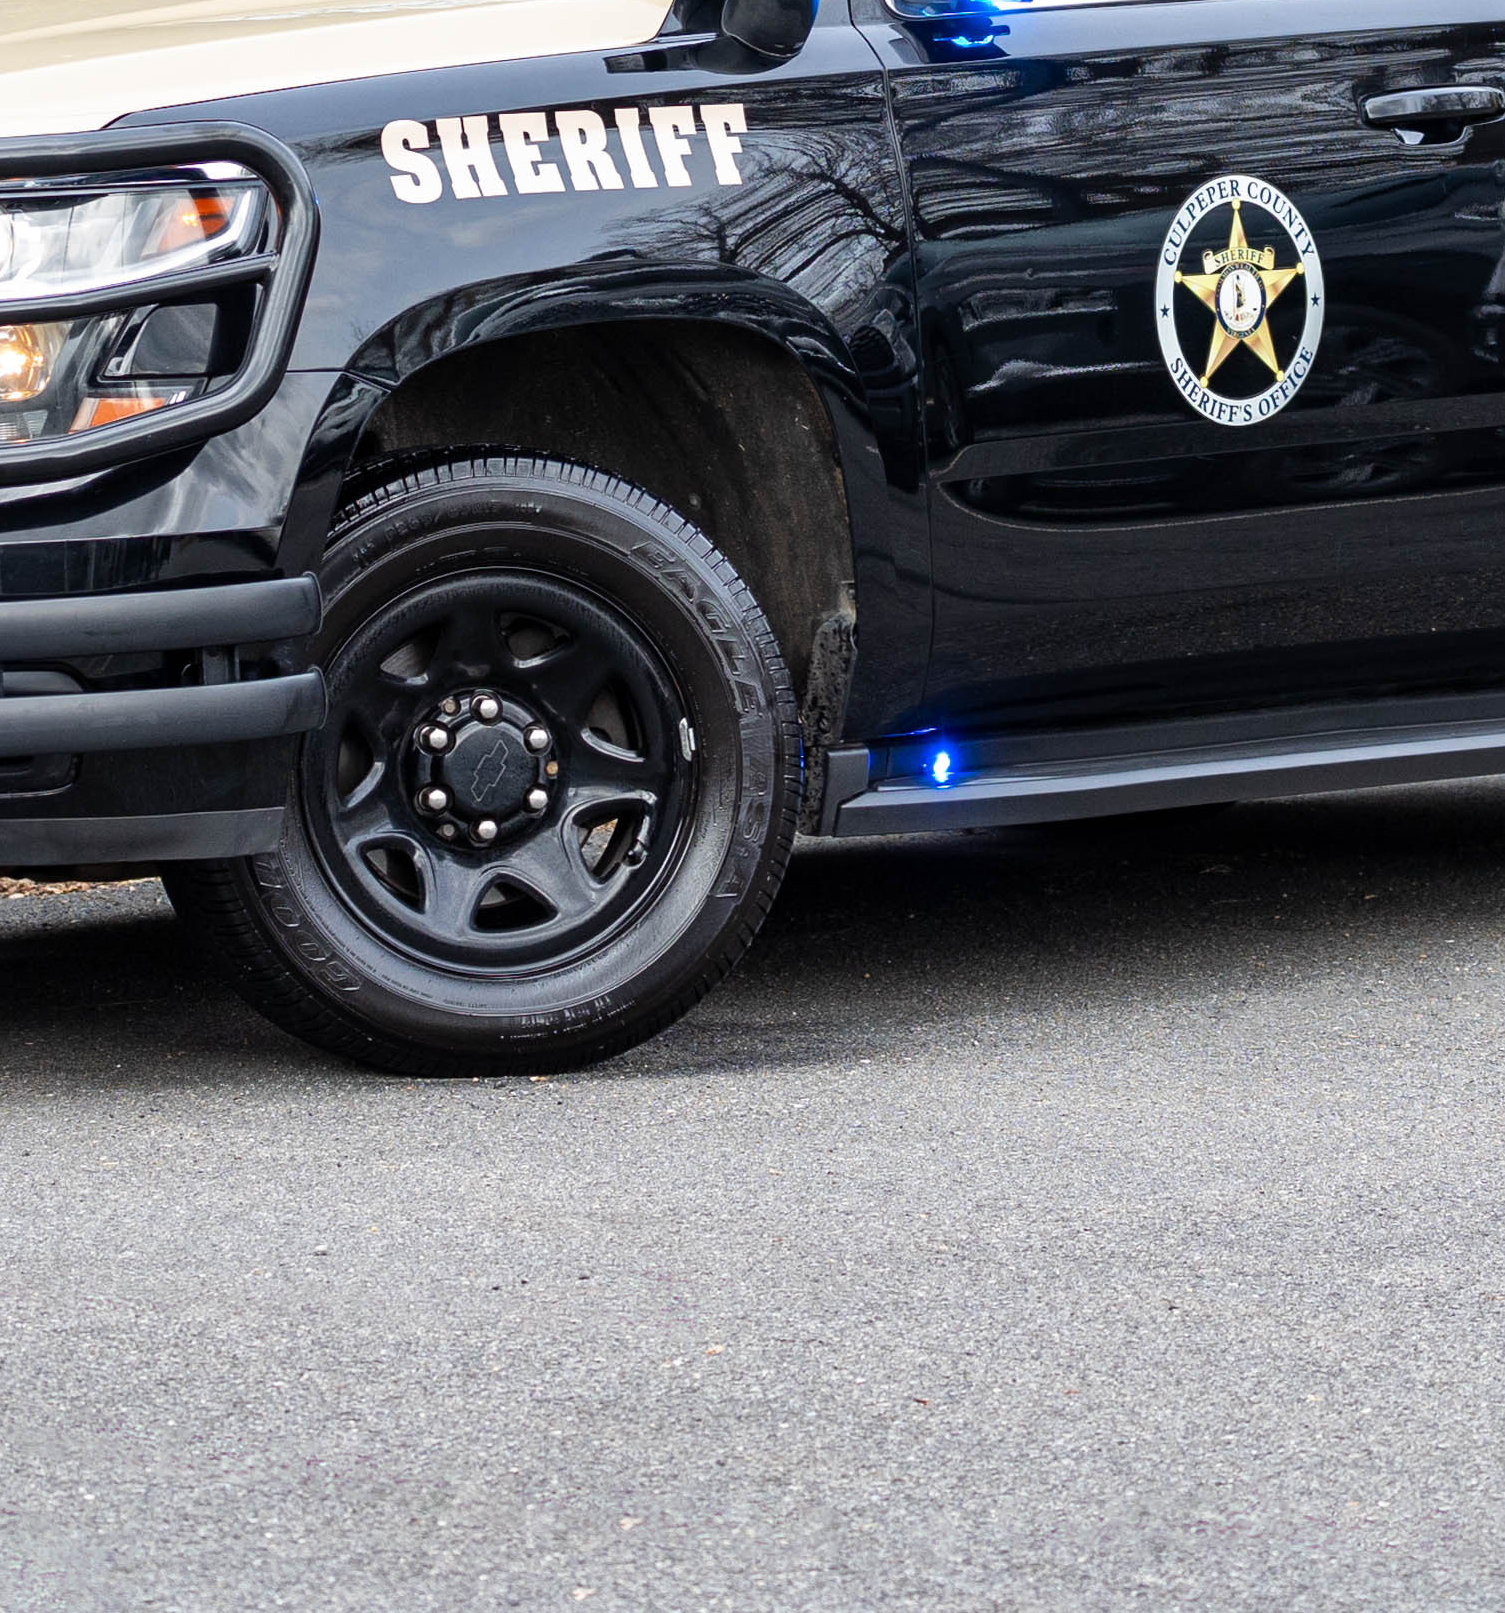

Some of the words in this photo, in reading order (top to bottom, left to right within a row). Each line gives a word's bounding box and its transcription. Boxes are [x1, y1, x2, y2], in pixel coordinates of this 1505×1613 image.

[380, 102, 748, 205] SHERIFF
[1164, 179, 1241, 267] CULPEPER
[1247, 181, 1315, 257] COUNTY
[1214, 249, 1265, 267] SHERIFF
[1170, 357, 1253, 423] SHERIFF'S
[1258, 346, 1314, 417] OFFICE
